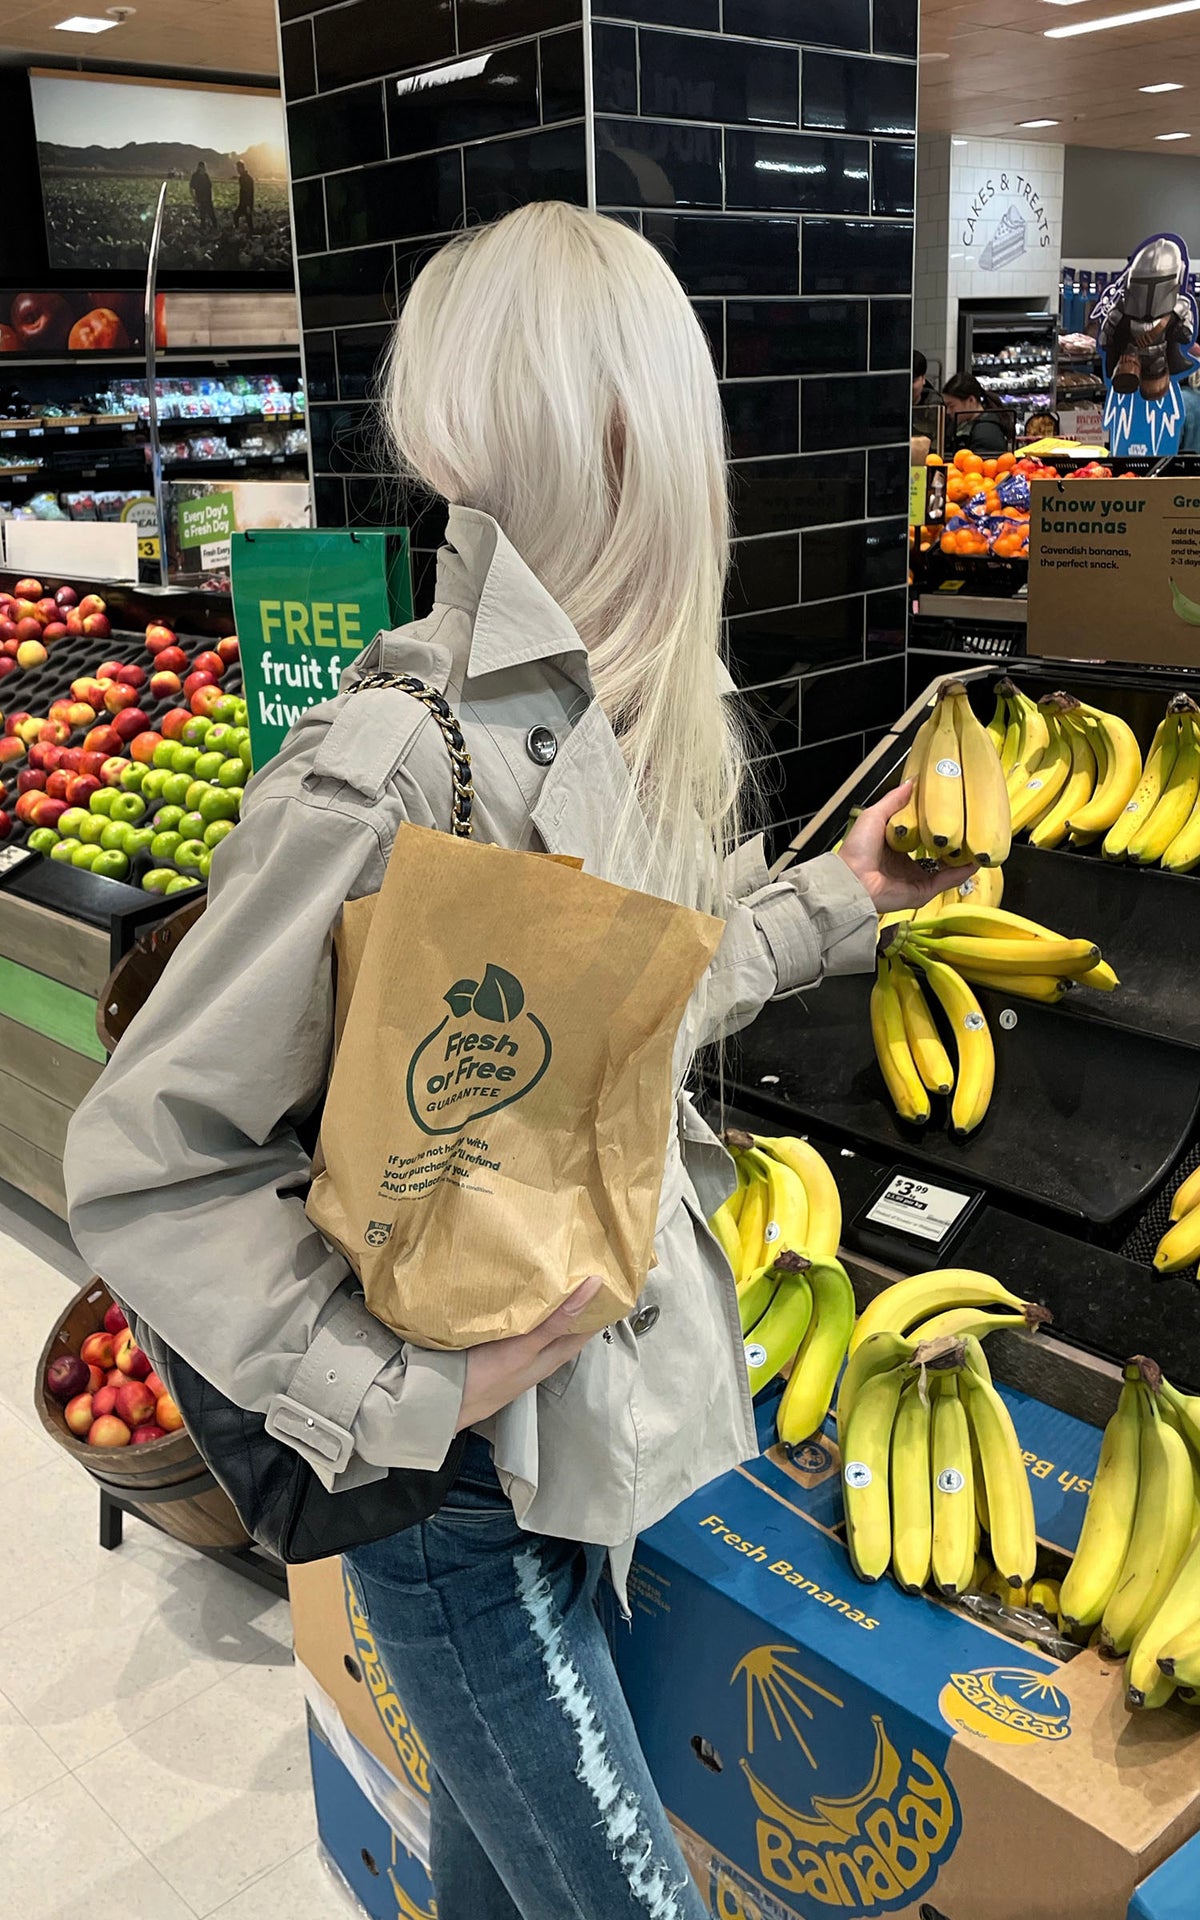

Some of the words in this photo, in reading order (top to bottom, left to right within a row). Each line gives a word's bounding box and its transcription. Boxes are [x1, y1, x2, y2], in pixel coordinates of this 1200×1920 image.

[962, 180, 995, 247] CAKES
[1000, 173, 1010, 191] &
[1017, 175, 1051, 248] TREATS
[183, 509, 205, 524] Every
[205, 503, 229, 520] Day's
[1042, 496, 1096, 512] Know
[1100, 500, 1146, 517] your
[184, 529, 190, 538] a
[190, 524, 212, 537] Fresh
[212, 519, 229, 533] Day
[1041, 517, 1127, 534] bananas
[1171, 527, 1187, 535] Add
[1040, 545, 1087, 555] Cavendish
[1089, 546, 1132, 557] bananas,
[1171, 538, 1198, 546] salads,
[1040, 559, 1055, 567] the
[1056, 559, 1088, 569] perfect
[1090, 560, 1119, 569] snack.
[259, 599, 364, 649] FREE
[260, 651, 323, 690] fruit
[444, 1031, 519, 1061] Fresh
[426, 1069, 455, 1094] or
[455, 1056, 516, 1085] Free
[426, 1086, 502, 1112] GUARANTEE
[388, 1154, 400, 1165] If
[426, 1145, 444, 1157] not
[466, 1137, 489, 1151] with
[383, 1168, 408, 1180] your
[465, 1155, 502, 1171] refund
[380, 1180, 407, 1194] AND
[698, 1515, 768, 1562] Fresh
[767, 1560, 880, 1630] Bananas
[950, 1673, 1071, 1741] BanaBay
[756, 1748, 954, 1907] BanaBay
